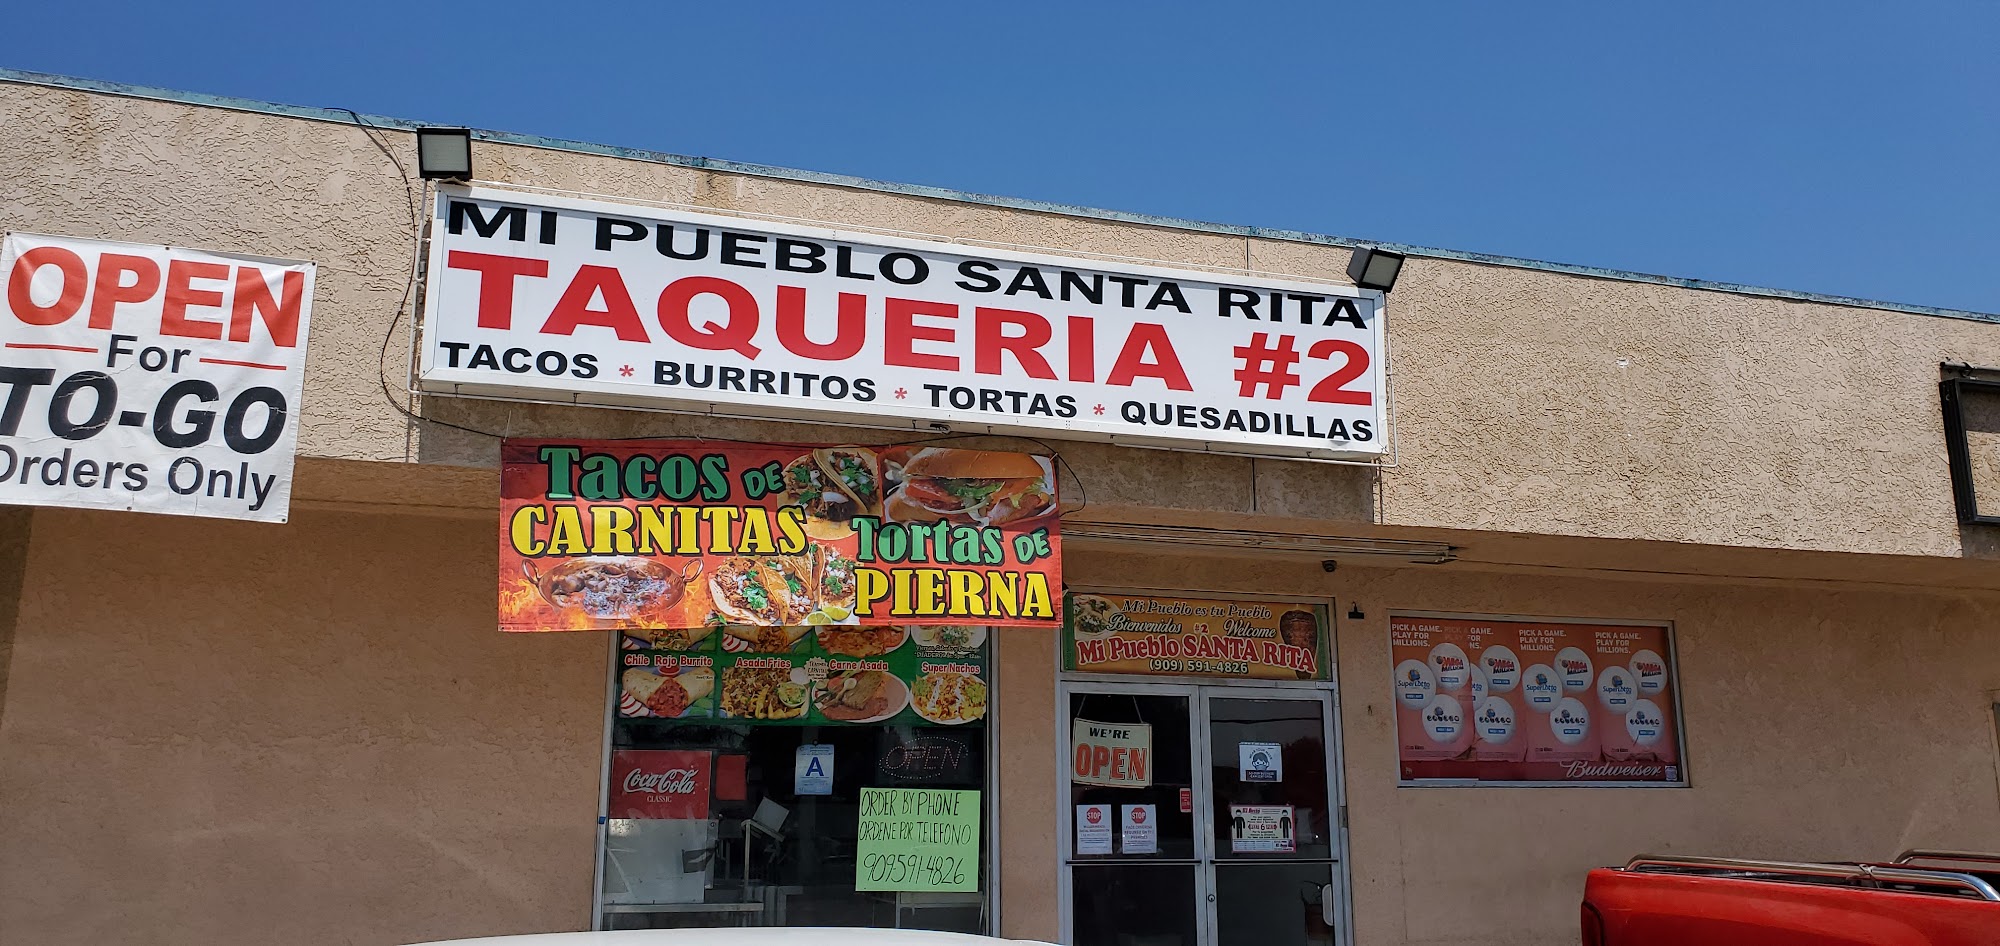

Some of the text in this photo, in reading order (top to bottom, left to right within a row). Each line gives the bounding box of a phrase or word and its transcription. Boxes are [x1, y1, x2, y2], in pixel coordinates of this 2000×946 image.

[448, 200, 1368, 329] MI PUEBLO SANTA RITA
[7, 246, 305, 348] OPEN
[447, 249, 1373, 406] TAQUERIA #2
[106, 334, 192, 373] For
[439, 341, 1373, 442] TACOS BURRITOS TORTAS QUESADILLAS
[0, 366, 288, 455] TO-GO
[538, 443, 787, 502] Tacos DE
[168, 456, 276, 511] Only
[508, 503, 814, 558] CARNITAS
[850, 515, 1051, 565] Tortas DE
[853, 565, 1056, 620] PIERNA
[1122, 600, 1273, 620] Mi Pueblo es tu Pueblo
[1106, 612, 1183, 634] Bienvenidos
[1223, 620, 1277, 638] Welcome
[1391, 623, 1410, 631] PICK
[1411, 624, 1417, 632] A
[1518, 629, 1536, 637] PICK
[1392, 639, 1431, 647] MILLIONS.
[1414, 632, 1429, 640] FOR
[1595, 631, 1612, 639] PICK
[1076, 633, 1318, 674] Mi Pueblo SANTA RITA
[1520, 644, 1556, 652] MILLIONS.
[1597, 646, 1631, 654] MILLIONS.
[624, 654, 714, 668] Chile Rojo Burrito
[734, 657, 792, 669] Asada Fries
[829, 659, 889, 671] Carne Asada
[922, 661, 981, 675] Super Nachos
[1149, 659, 1249, 674] (909) 591-4826
[1089, 726, 1131, 740] WE'RE
[805, 756, 825, 777] A
[886, 745, 963, 770] OPEN
[1075, 742, 1148, 782] OPEN
[1560, 760, 1661, 778] Budweiser
[623, 768, 699, 793] Coca-Cola
[646, 795, 672, 803] CLASSIC
[861, 790, 962, 817] ORDER BY PHONE
[1086, 812, 1102, 820] STOP
[1131, 812, 1146, 820] STOP
[859, 820, 972, 846] ORDENE POR TELEFONO
